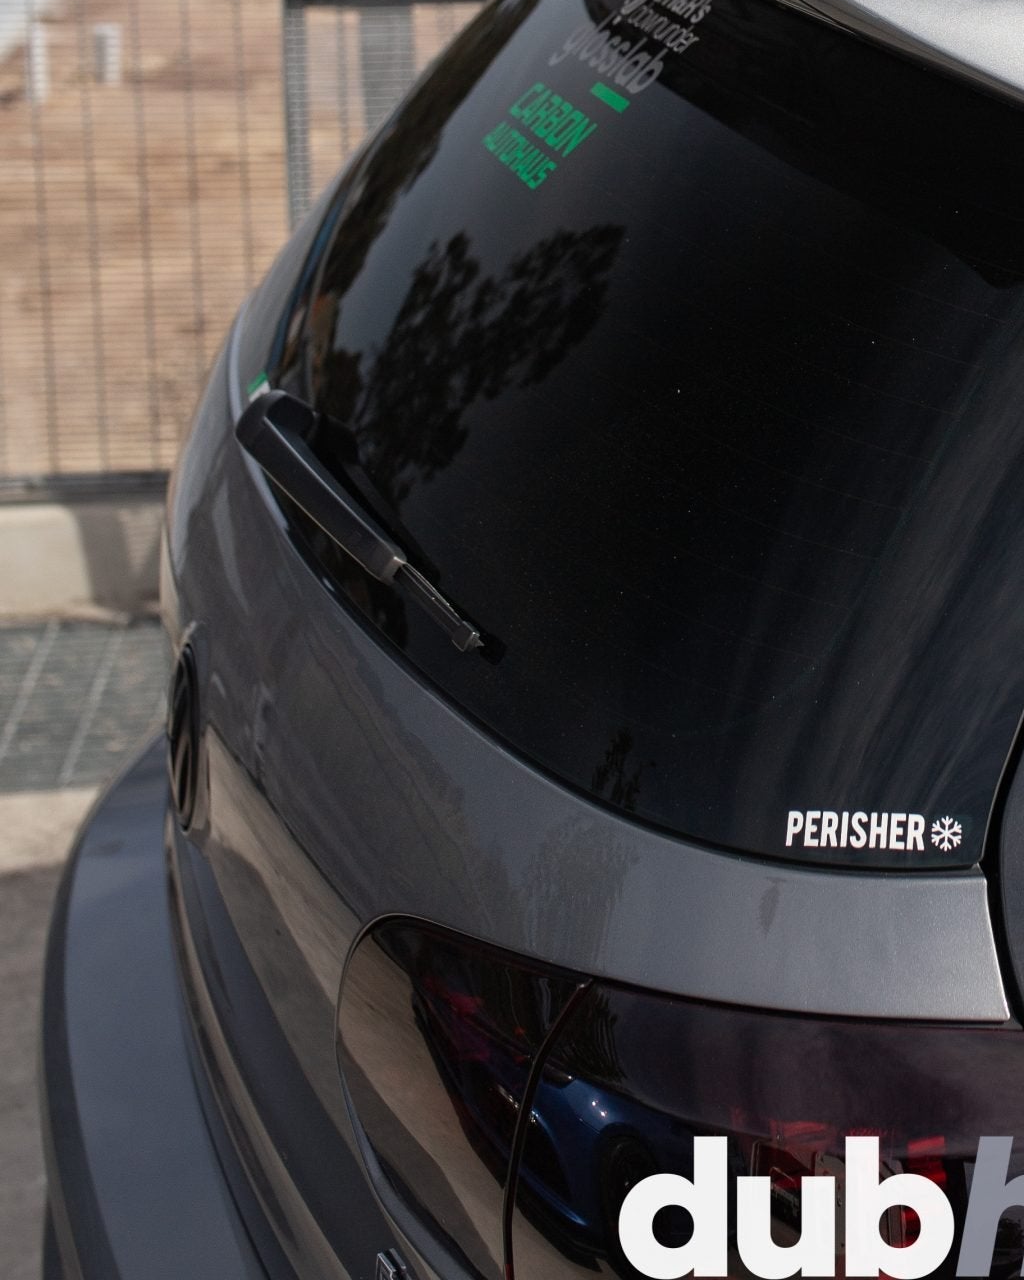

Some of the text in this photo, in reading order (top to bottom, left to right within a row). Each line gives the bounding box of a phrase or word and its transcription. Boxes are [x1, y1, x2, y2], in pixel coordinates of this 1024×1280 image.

[548, 10, 664, 94] glosslab
[508, 81, 598, 158] CARBON
[786, 810, 926, 852] PERISHER
